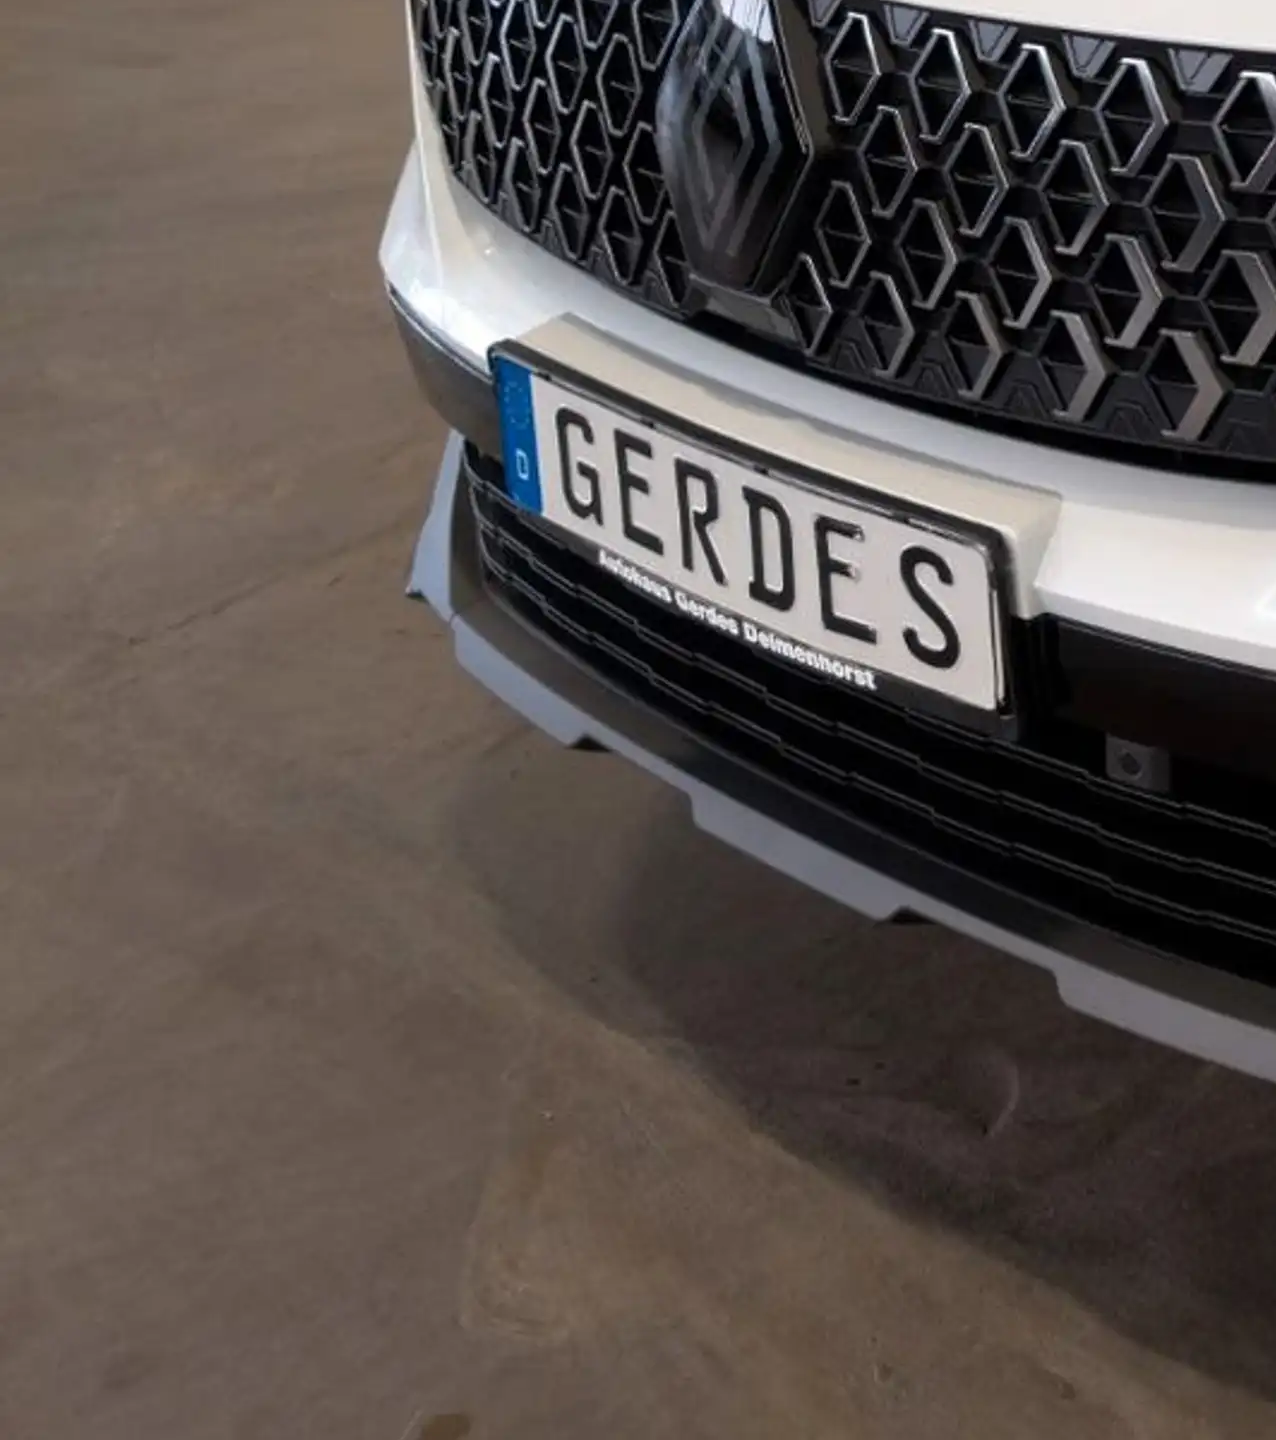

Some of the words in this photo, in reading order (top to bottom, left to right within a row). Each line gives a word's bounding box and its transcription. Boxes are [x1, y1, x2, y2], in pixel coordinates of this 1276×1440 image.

[516, 448, 530, 481] D
[555, 406, 960, 669] GERDES
[674, 589, 739, 636] Gerdes
[743, 621, 877, 691] Delmenhorst
